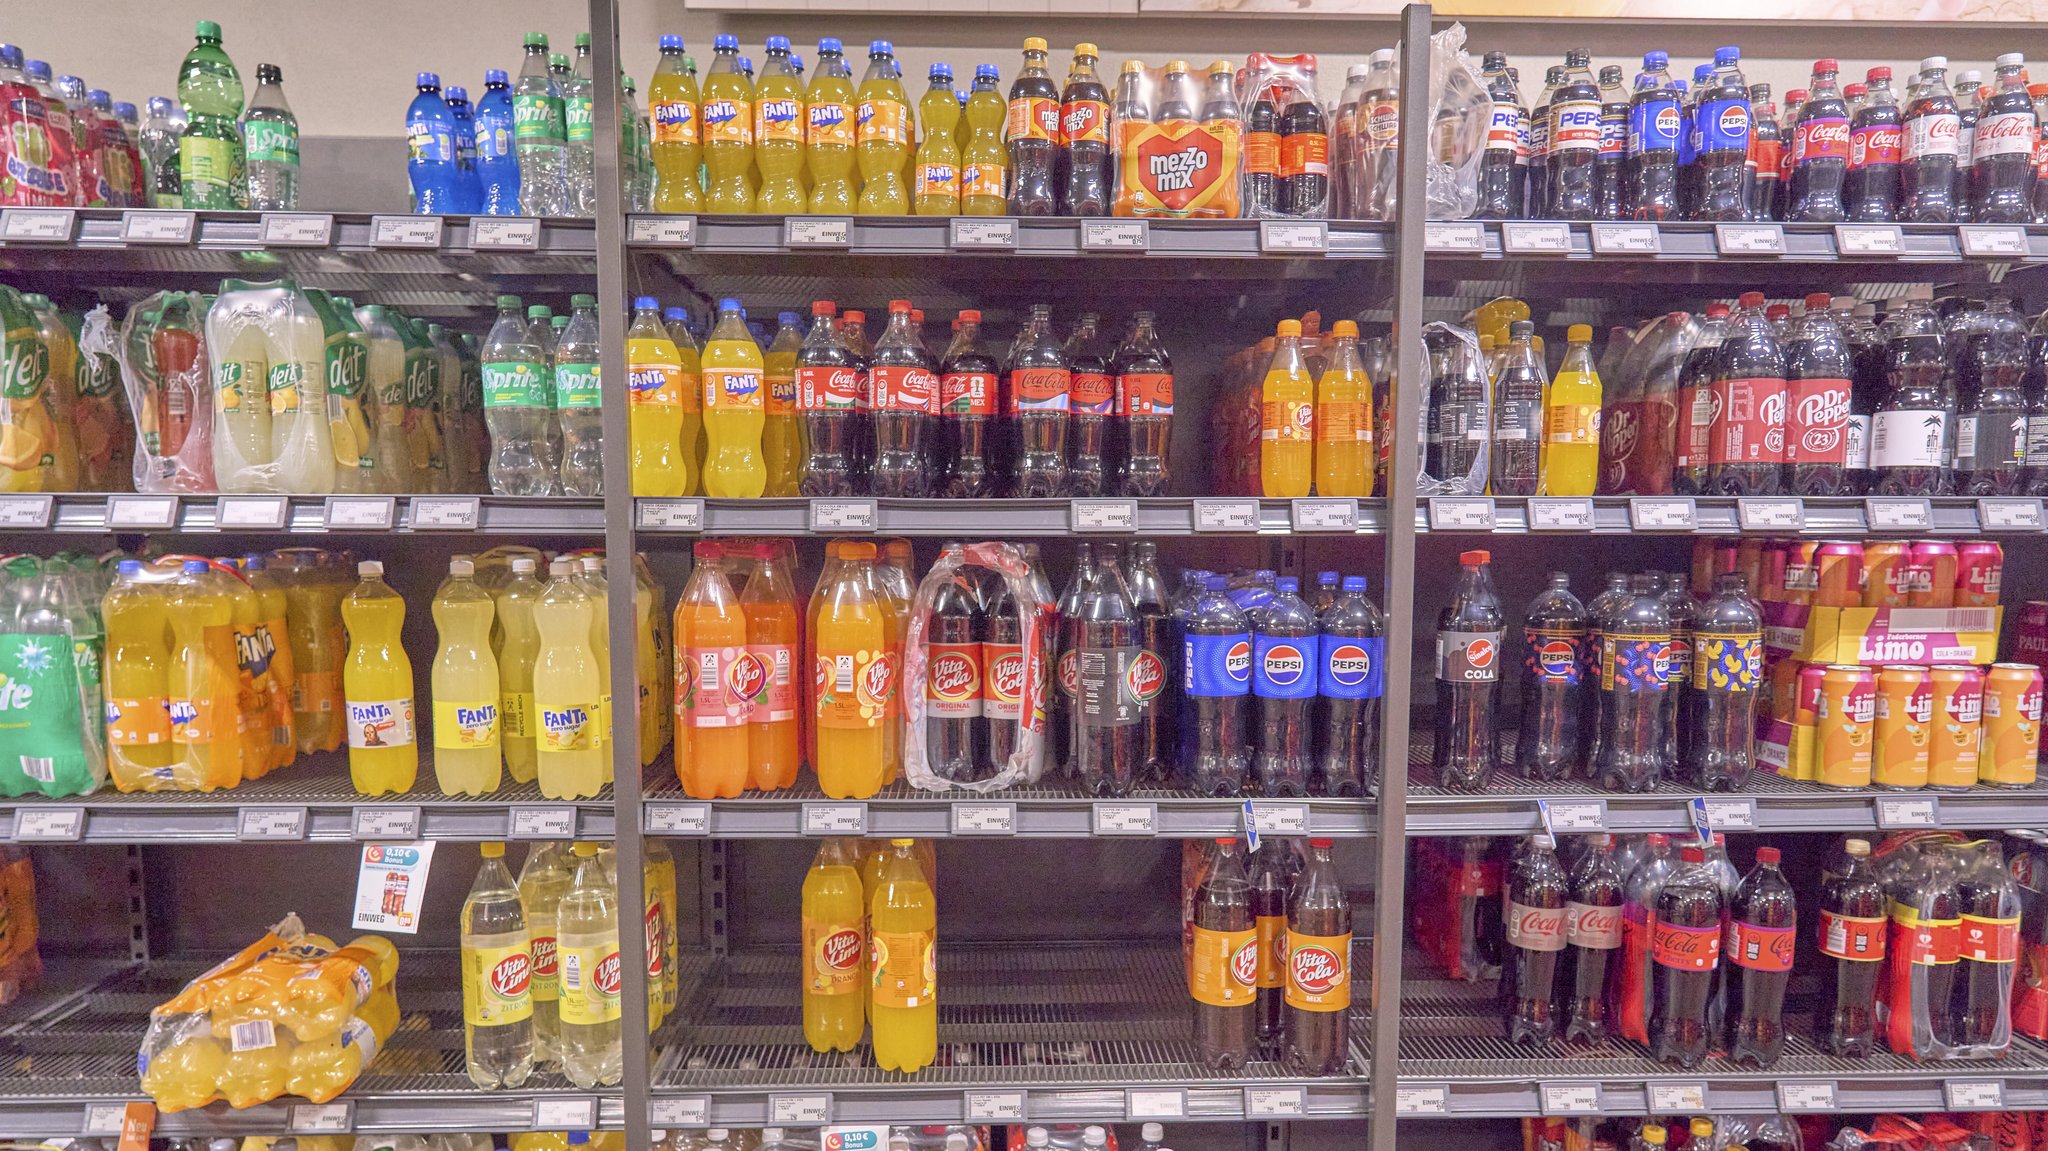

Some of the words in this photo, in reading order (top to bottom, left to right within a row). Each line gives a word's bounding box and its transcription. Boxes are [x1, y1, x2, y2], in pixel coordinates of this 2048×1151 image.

[655, 103, 691, 119] FANTA
[704, 102, 736, 118] FANTA
[763, 102, 799, 118] FANTA
[810, 105, 844, 121] FANTA
[1063, 106, 1092, 125] mezzo
[1066, 119, 1085, 133] mix
[1150, 146, 1208, 175] mezzo
[927, 166, 953, 178] FANTA
[1157, 166, 1194, 192] mix
[270, 363, 298, 387] deit
[330, 346, 365, 388] deit
[485, 367, 539, 394] Sprite
[630, 369, 665, 386] FANTA
[724, 374, 759, 389] FANTA
[1022, 371, 1066, 390] Coca-Cola
[970, 399, 985, 407] MEX
[1823, 390, 1845, 409] Dr
[1814, 432, 1829, 446] 23
[234, 624, 276, 664] FANTA
[1857, 635, 1925, 661] Limo
[1468, 645, 1492, 662] Sinalco
[1542, 653, 1573, 662] PEPSI
[933, 660, 967, 677] Vita
[1267, 660, 1301, 670] PEPSI
[1332, 660, 1367, 670] PEPSI
[936, 671, 972, 692] Cola
[1464, 669, 1494, 680] COLA
[352, 705, 392, 721] FANTA
[457, 705, 497, 724] FANTA
[544, 708, 587, 727] FANTA
[564, 723, 580, 733] sugar
[384, 856, 404, 865] Bonus
[386, 847, 404, 856] 0,10
[404, 849, 412, 858] €
[358, 912, 385, 924] EINWEG
[826, 932, 856, 952] Vita
[830, 940, 860, 966] Limo
[1294, 952, 1331, 970] Vita
[495, 958, 528, 980] Vita
[1296, 966, 1336, 984] Cola
[1306, 995, 1322, 1003] MIX
[127, 1118, 147, 1131] Neu
[844, 1133, 862, 1142] 0,10
[862, 1132, 868, 1140] €
